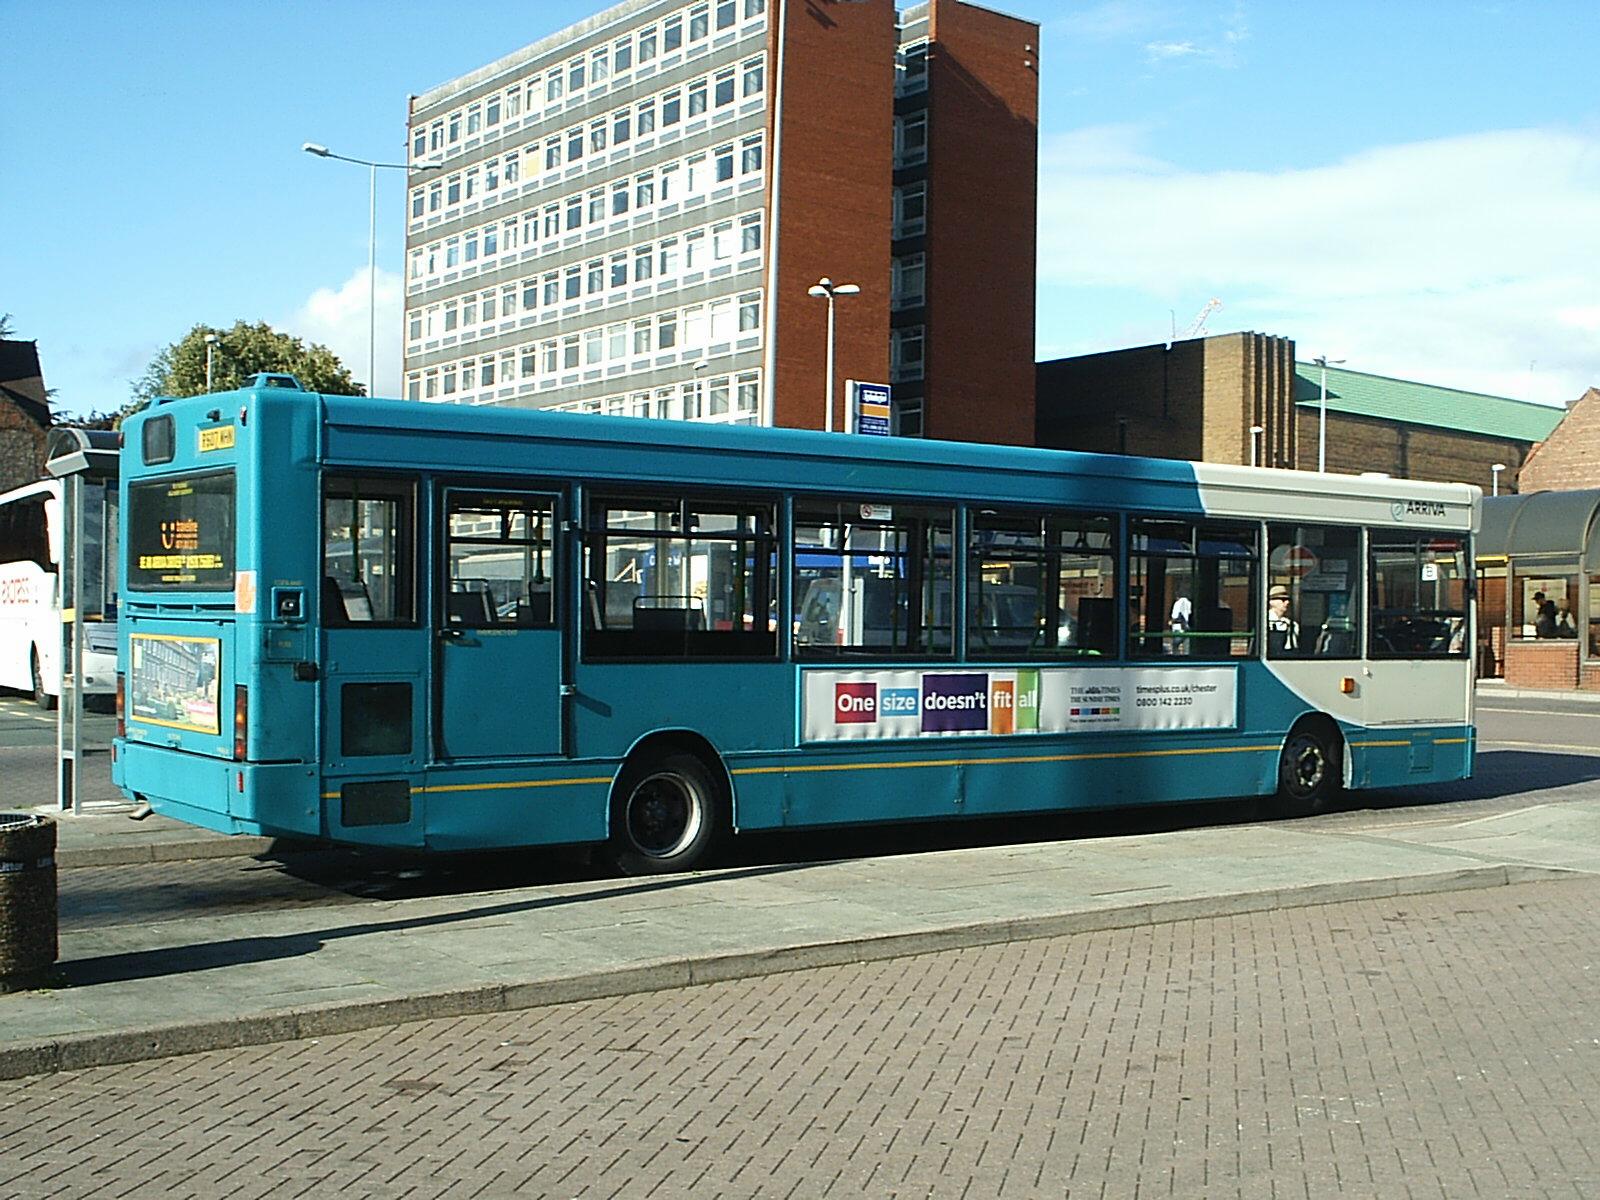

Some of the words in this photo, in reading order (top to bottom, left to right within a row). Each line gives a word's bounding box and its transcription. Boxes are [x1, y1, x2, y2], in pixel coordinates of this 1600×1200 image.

[1406, 501, 1446, 516] ARRIVA
[837, 693, 875, 712] One
[882, 692, 915, 711] size
[924, 691, 986, 711] doesn't
[993, 690, 1012, 708] fit
[1018, 689, 1037, 708] all
[1136, 697, 1157, 707] 0800
[1159, 697, 1172, 706] 142
[1173, 697, 1193, 706] 2230
